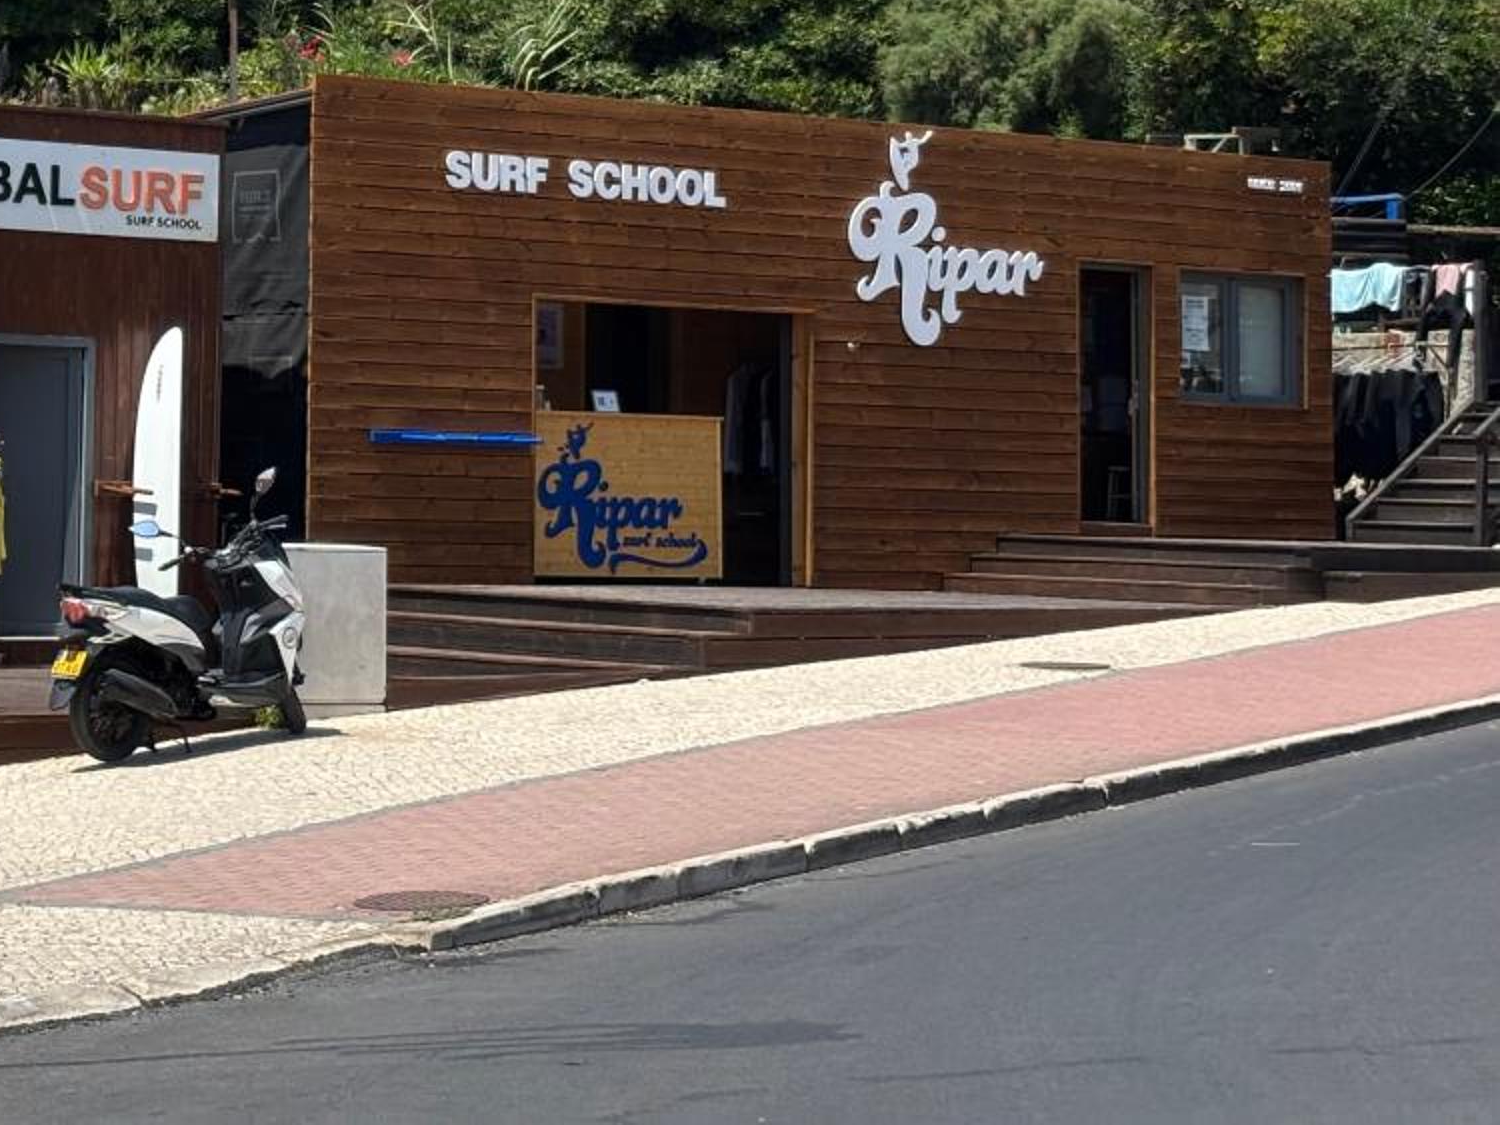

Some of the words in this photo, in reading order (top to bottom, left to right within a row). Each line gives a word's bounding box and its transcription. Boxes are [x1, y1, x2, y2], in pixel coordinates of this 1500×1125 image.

[126, 214, 155, 228] SURF
[157, 217, 203, 231] SCHOOL
[445, 150, 549, 194] SURF
[567, 159, 727, 210] SCHOOL
[847, 181, 1045, 347] Ripar
[538, 459, 683, 569] Ripar
